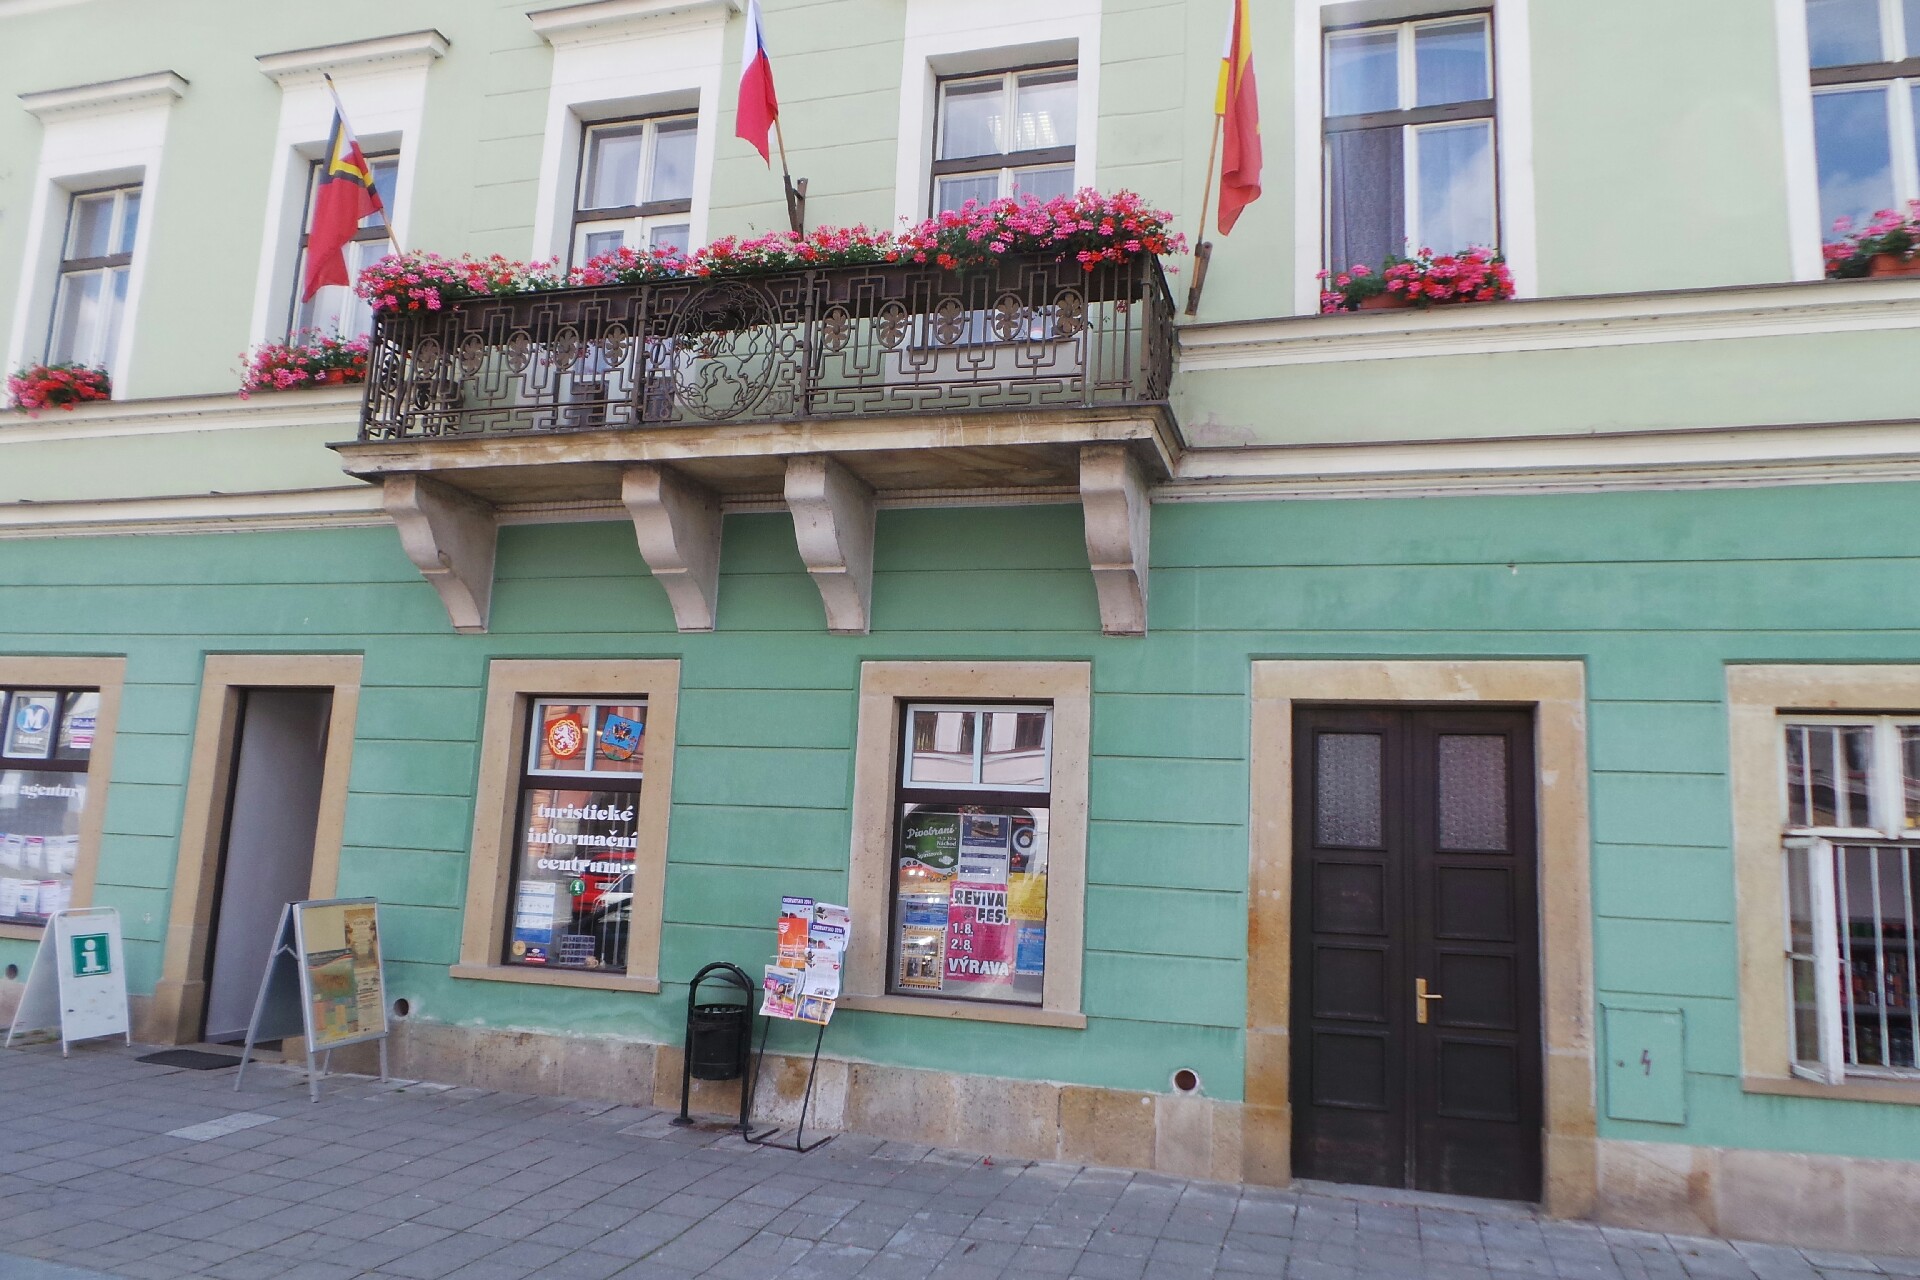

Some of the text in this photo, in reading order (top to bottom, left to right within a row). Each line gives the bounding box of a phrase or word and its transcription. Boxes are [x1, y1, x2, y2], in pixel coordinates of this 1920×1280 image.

[22, 708, 46, 729] M
[537, 803, 633, 821] turistické
[527, 827, 638, 848] informační
[906, 823, 955, 839] Pivobraní
[537, 857, 621, 873] centrum
[948, 956, 1009, 976] VÝRAVA
